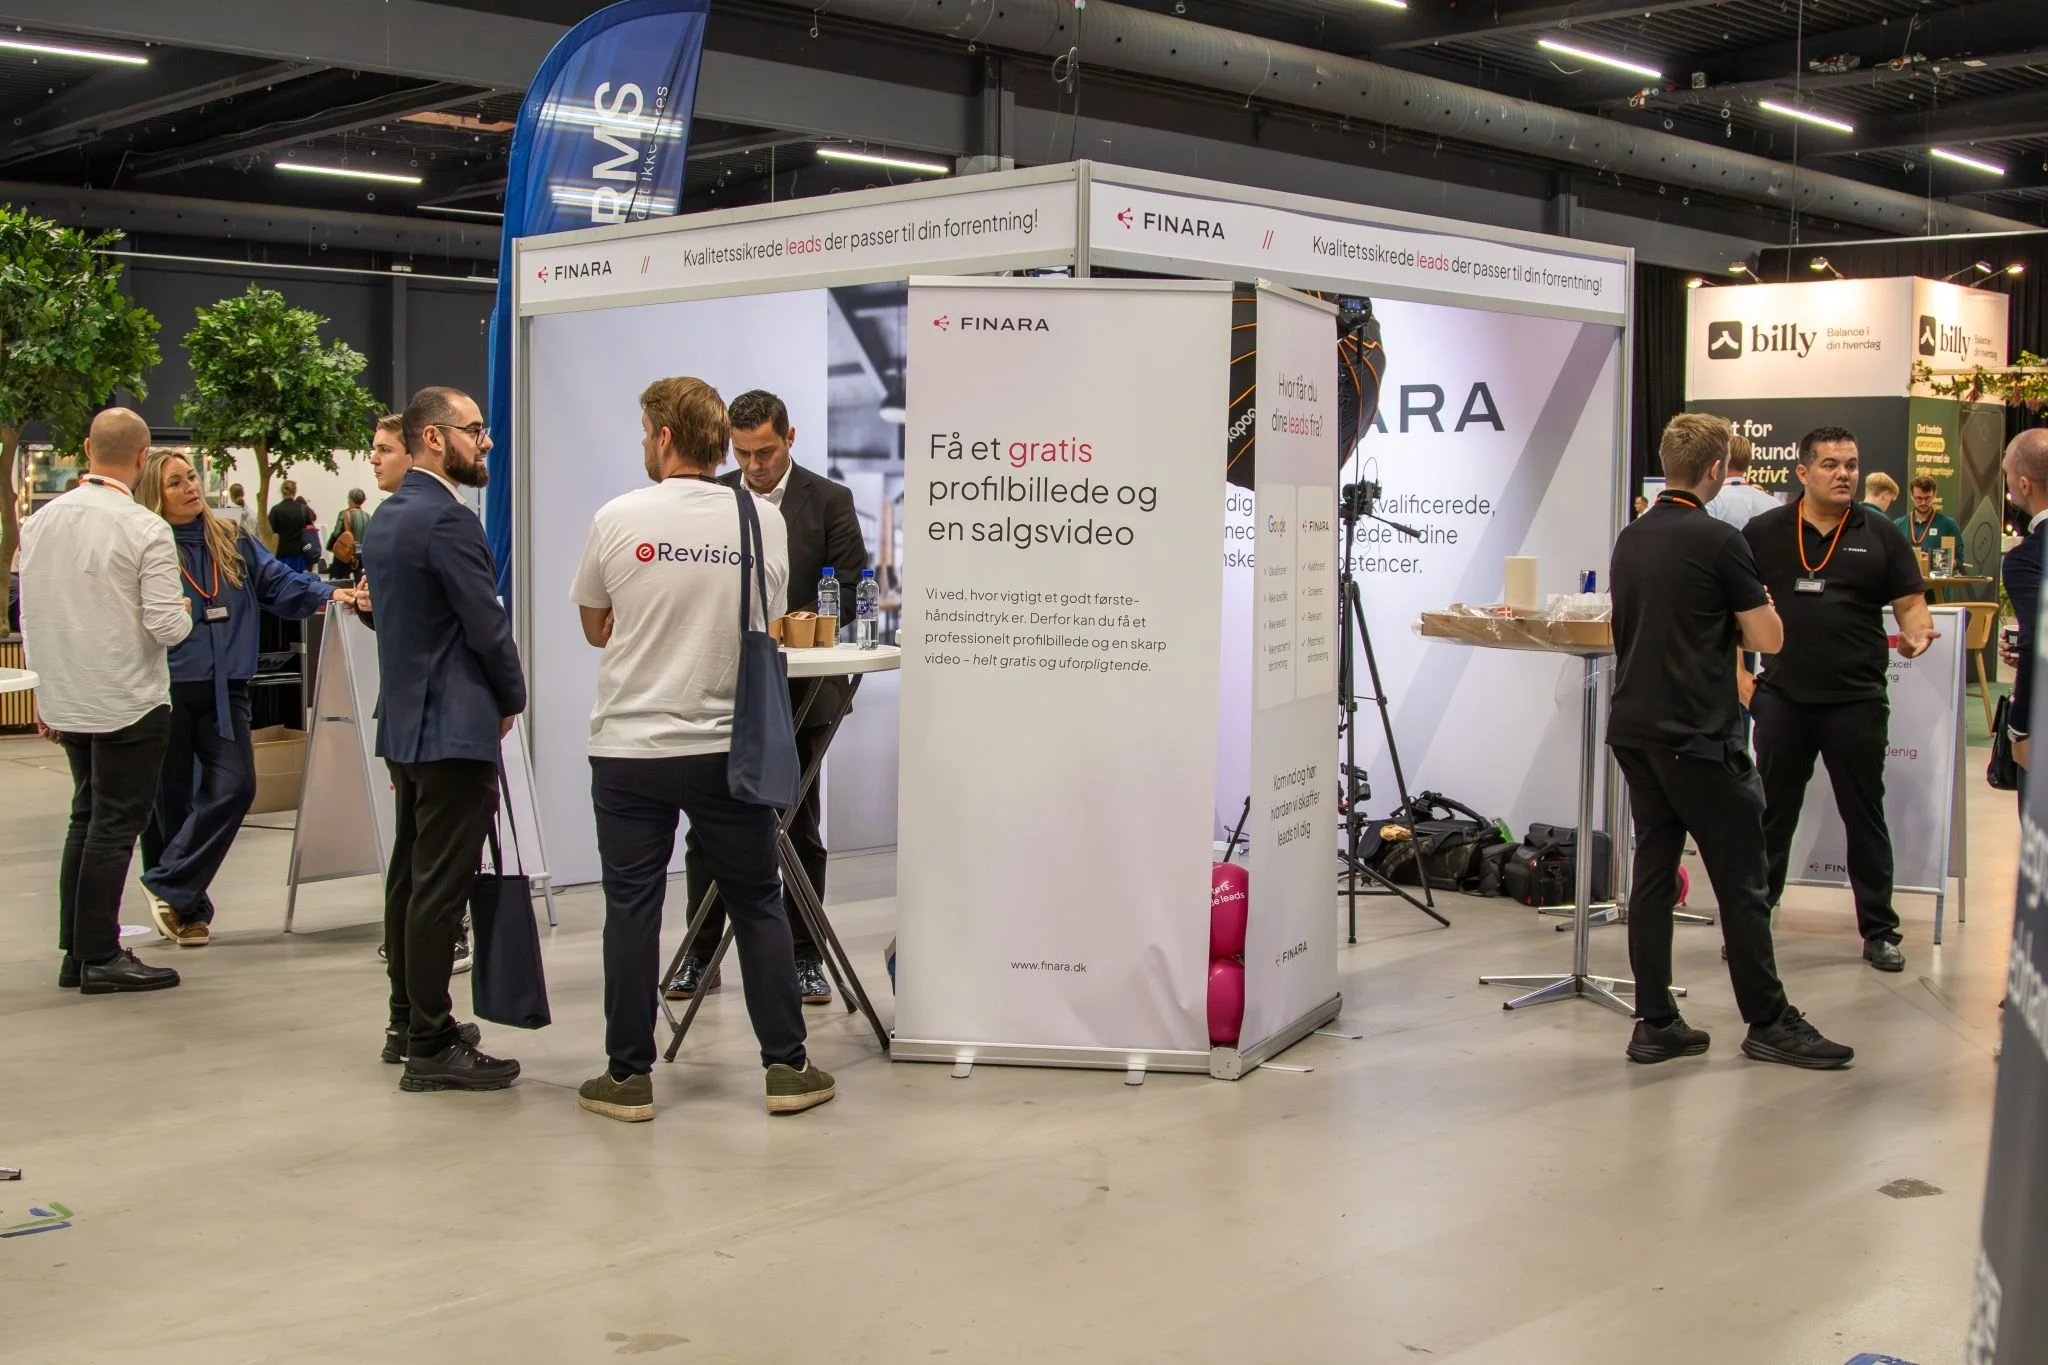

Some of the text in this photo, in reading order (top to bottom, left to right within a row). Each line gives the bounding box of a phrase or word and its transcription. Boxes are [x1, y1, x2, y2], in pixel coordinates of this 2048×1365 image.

[555, 260, 612, 280] FINARA
[684, 239, 783, 266] Kvalitetssikrede
[785, 235, 822, 256] leads
[824, 232, 848, 251] der
[850, 227, 900, 252] passer
[902, 222, 914, 241] til
[918, 221, 941, 240] din
[944, 208, 1038, 238] forrentning!
[1144, 212, 1225, 239] FINARA
[1313, 235, 1414, 266] Kvalitetssikrede
[1416, 250, 1449, 272] leads
[1451, 256, 1471, 274] der
[1473, 260, 1511, 280] passer
[1512, 264, 1522, 281] til
[1524, 267, 1541, 284] din
[1542, 270, 1602, 296] forrentning!
[960, 317, 1050, 332] FINARA
[1826, 327, 1865, 337] Balance
[1751, 322, 1817, 358] billy
[1826, 339, 1881, 351] din hverdag
[1940, 323, 1971, 362] billy
[1278, 372, 1318, 402] Hvor får du
[1271, 408, 1323, 438] dine leads fra?
[1743, 418, 1773, 437] for
[930, 431, 1093, 468] Få et gratis
[929, 475, 1157, 512] profilbillede og
[928, 516, 1134, 549] en salgsvideo
[1309, 520, 1329, 532] FINARA
[1417, 524, 1458, 544] dine
[925, 587, 1140, 606] Vi ved, hvor vigtigt et godt første-
[925, 608, 1146, 628] håndsindtryk er. Derfor kan du få et
[925, 631, 1167, 652] professionelt profilbillede og en skarp
[924, 652, 960, 664] video
[972, 653, 997, 666] helt
[1000, 655, 1036, 669] gratis
[1038, 658, 1056, 670] og
[1059, 656, 1151, 673] uforpligtende.
[1824, 863, 1848, 873] FIN
[1220, 891, 1245, 904] leads
[1282, 941, 1308, 963] FINARA
[1010, 960, 1087, 973] www.finara.dk
